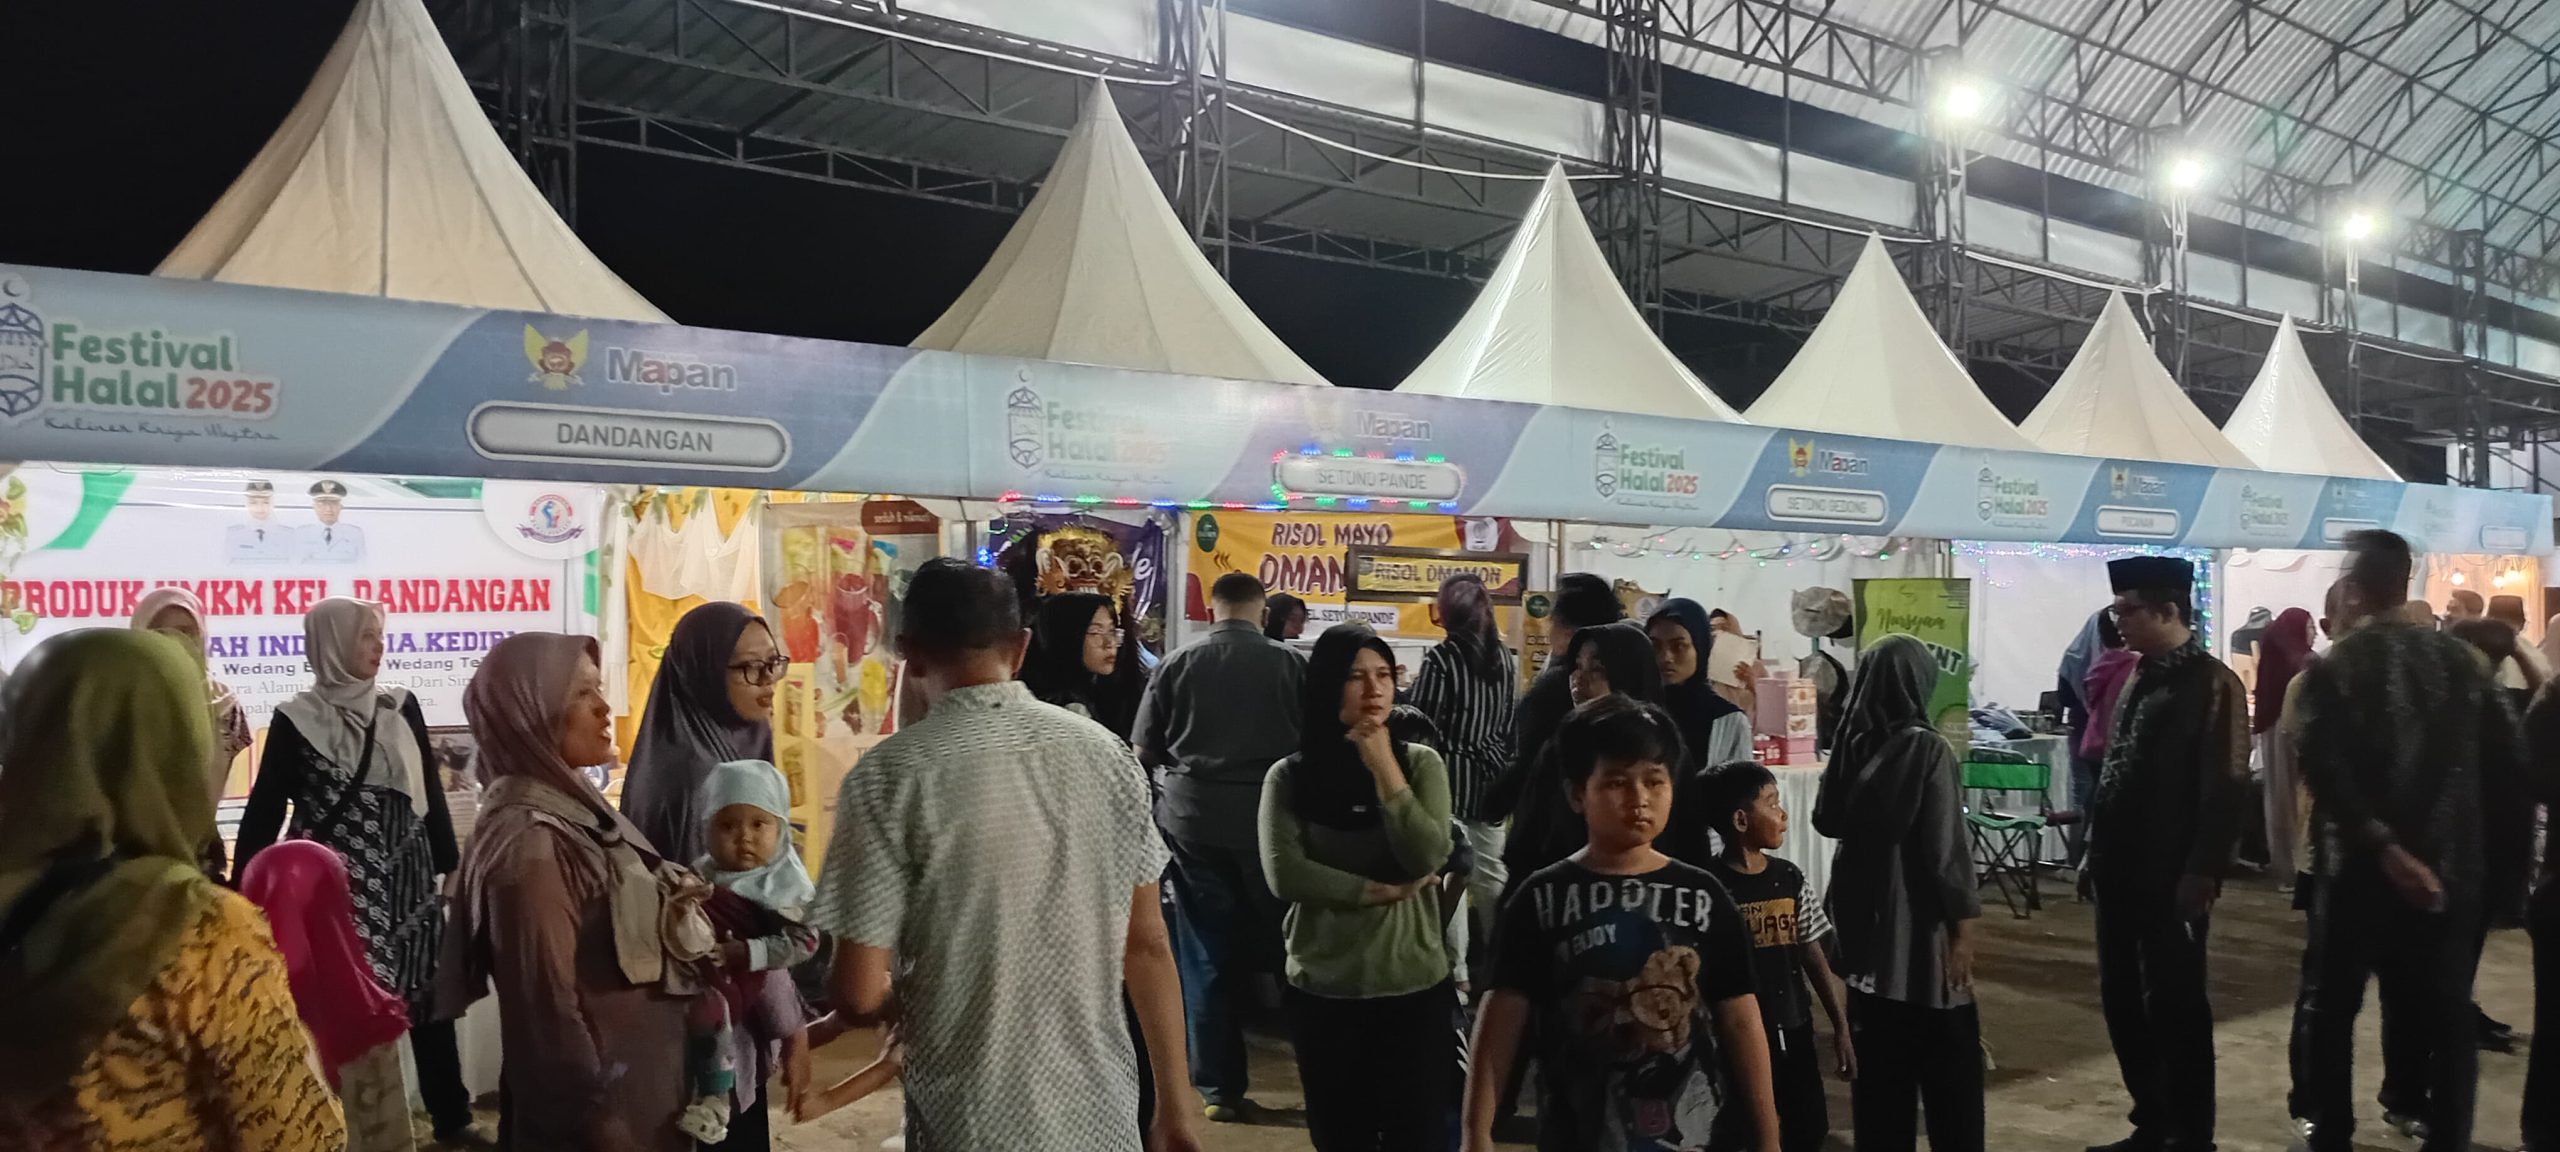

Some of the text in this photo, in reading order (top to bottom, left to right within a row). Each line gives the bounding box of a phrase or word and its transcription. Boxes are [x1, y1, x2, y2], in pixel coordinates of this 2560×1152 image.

[52, 323, 234, 371] Festival
[608, 348, 736, 394] Mapan
[52, 365, 275, 414] Halal 2025
[556, 422, 714, 453] DANDANGAN
[1354, 410, 1432, 444] Mapan
[1620, 444, 1685, 470] Festival
[1379, 471, 1429, 490] PANDE
[1620, 467, 1699, 495] Halal 2025
[1271, 522, 1393, 548] RISOL MAYO
[1374, 562, 1421, 582] RISOL
[1, 580, 145, 619] PRODUK
[156, 580, 264, 616] MKM
[352, 578, 551, 614] DANDANGAN
[222, 662, 297, 677] Wedang
[386, 658, 454, 672] Wedang
[256, 680, 304, 694] Alami
